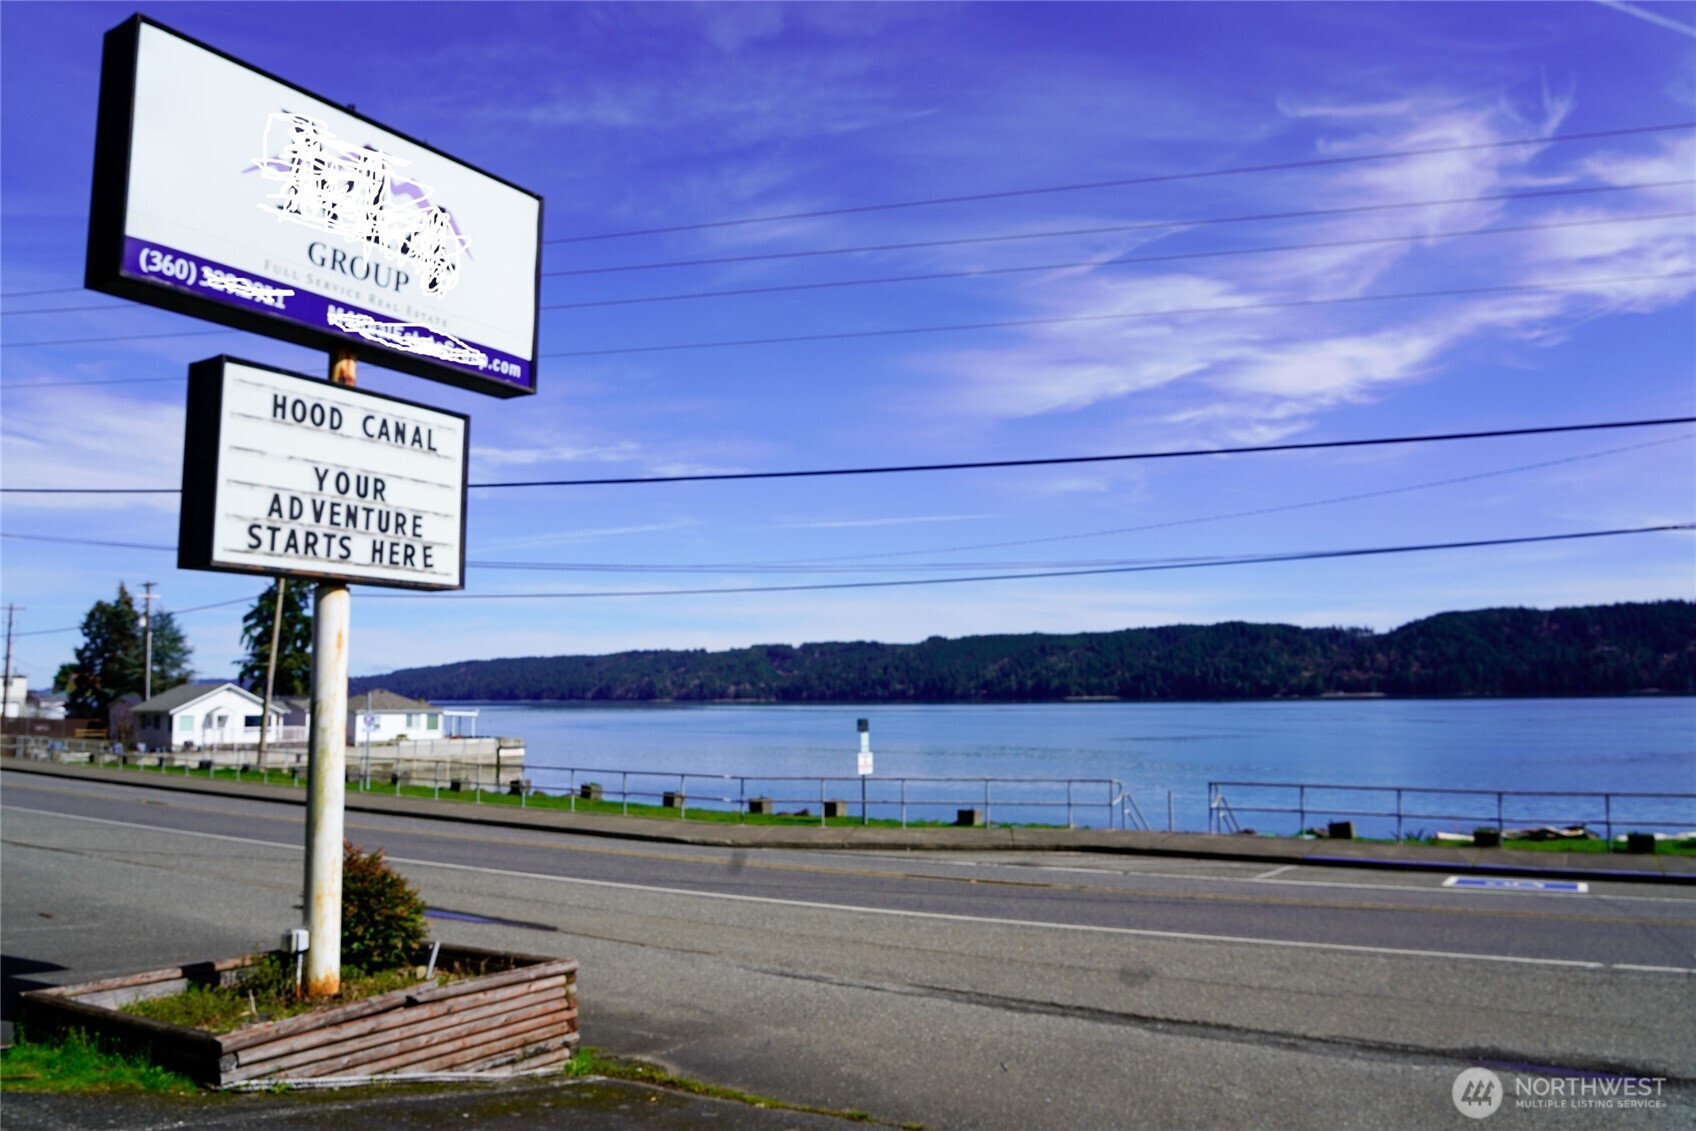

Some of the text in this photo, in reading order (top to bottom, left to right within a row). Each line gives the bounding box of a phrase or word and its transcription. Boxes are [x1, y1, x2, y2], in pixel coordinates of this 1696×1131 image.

[139, 248, 197, 286] (360)
[307, 241, 409, 292] GROUP
[272, 394, 438, 452] HOOD CANAL
[314, 467, 386, 501] YOUR
[268, 494, 423, 538] ADVENTURE
[248, 524, 434, 568] STARTS HERE
